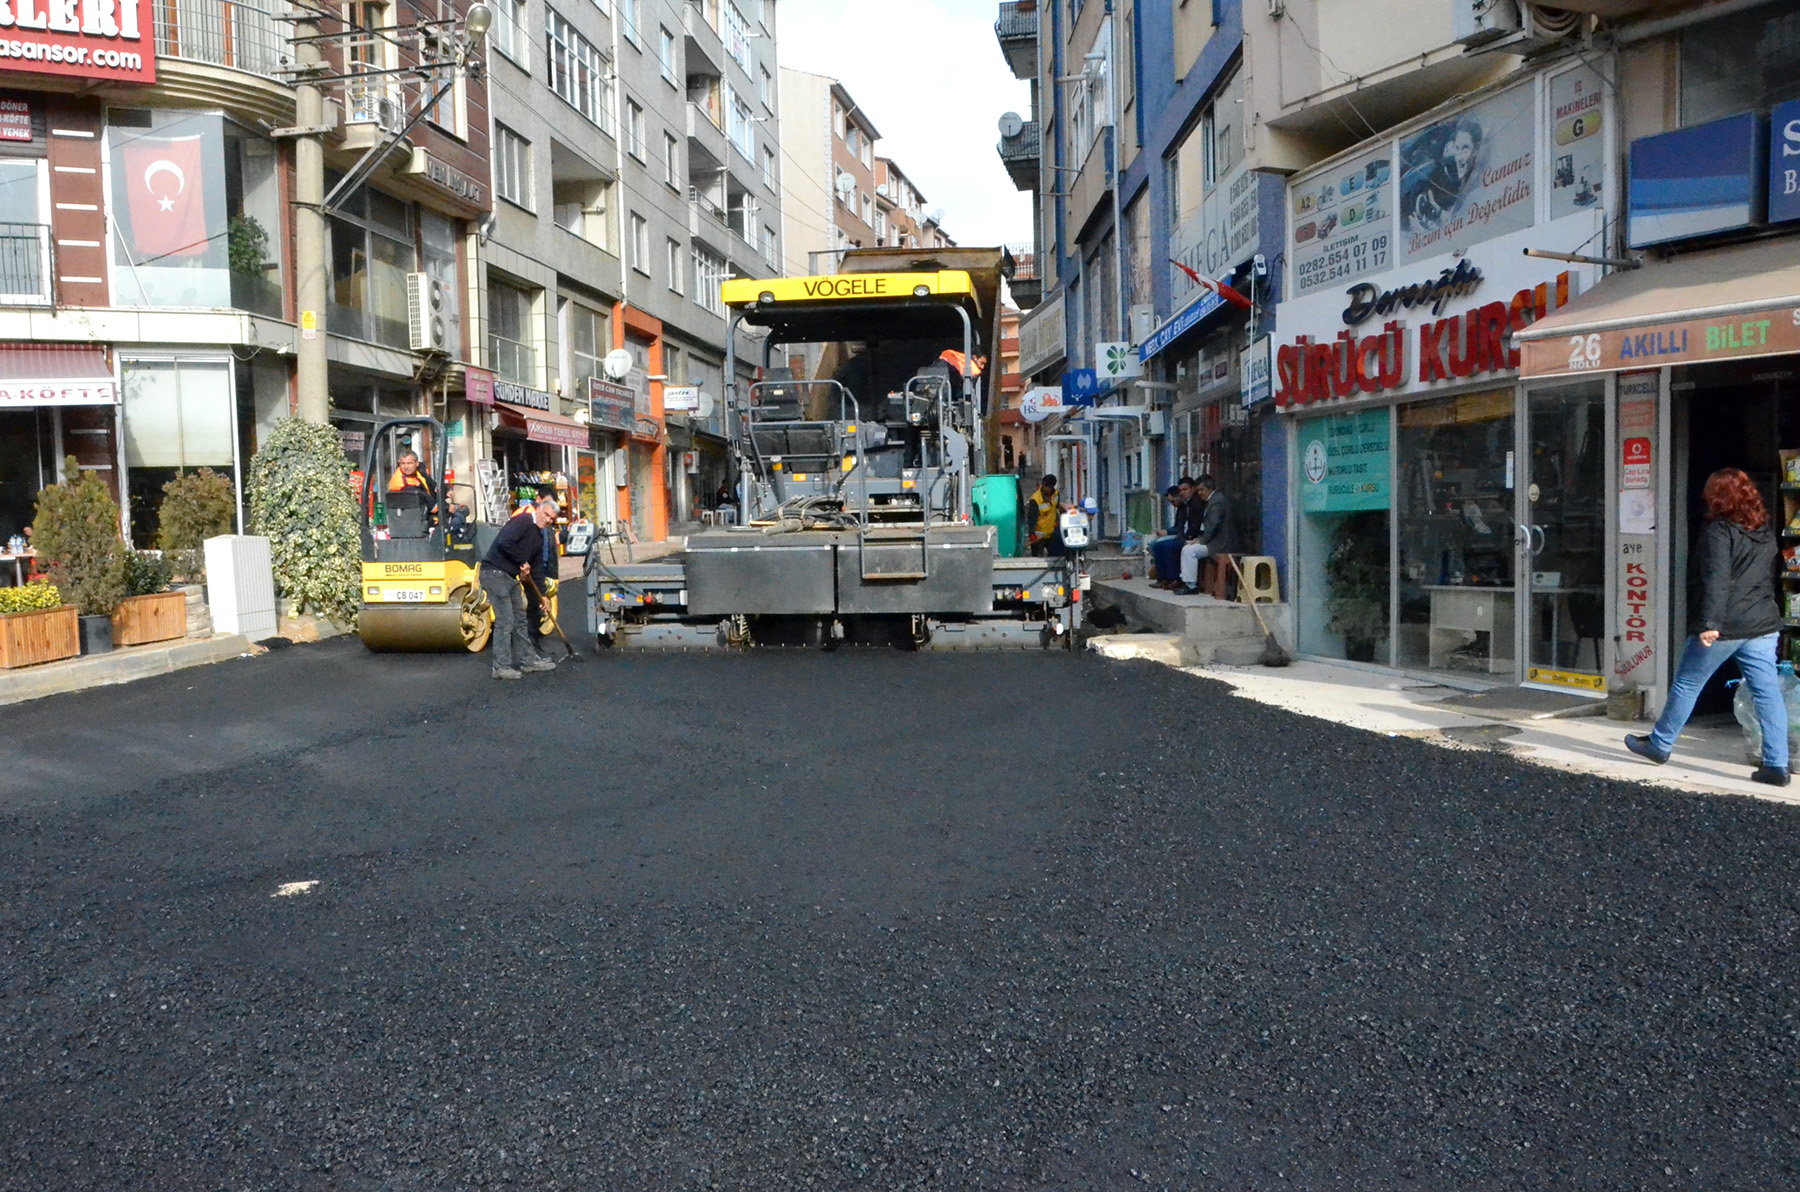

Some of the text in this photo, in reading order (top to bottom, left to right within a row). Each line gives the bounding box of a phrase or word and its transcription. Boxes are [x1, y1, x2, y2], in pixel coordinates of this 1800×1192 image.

[0, 112, 30, 125] -KÖFTE
[1572, 118, 1584, 138] G
[3, 127, 30, 138] YEMEK
[1300, 176, 1355, 211] A2 E
[1349, 207, 1356, 222] D
[1299, 235, 1387, 276] 0282.654 07 09
[1300, 250, 1387, 289] 0532.544 11 17
[803, 277, 887, 297] VÖGELE
[1568, 333, 1601, 361] 26
[1620, 329, 1688, 360] AKILLI
[1275, 320, 1406, 407] SÜRÜCÜ
[1569, 359, 1600, 370] NOLU
[493, 381, 525, 405] GÜNDEM
[1023, 404, 1040, 414] HS
[384, 563, 422, 573] BOMAG
[1626, 562, 1648, 642] KONTÖR
